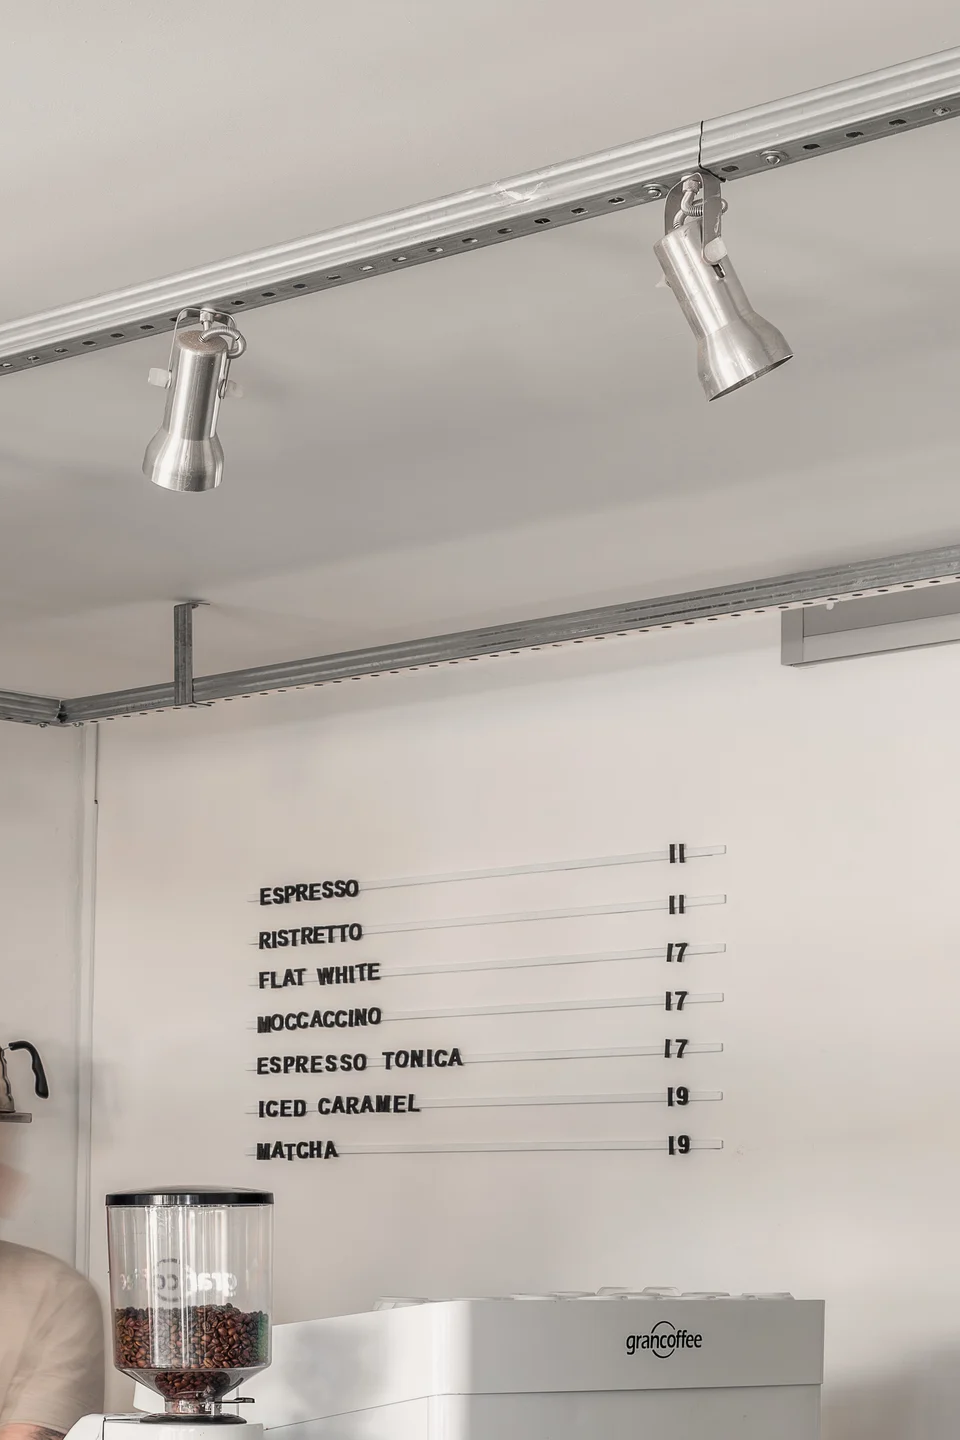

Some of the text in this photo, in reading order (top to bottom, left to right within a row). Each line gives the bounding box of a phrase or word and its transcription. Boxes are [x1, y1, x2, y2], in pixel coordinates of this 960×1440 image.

[259, 843, 686, 906] ESPRESSO 11
[258, 894, 686, 950] RISTRETTO 11
[258, 942, 688, 989] FLAT WHITE 17
[257, 990, 688, 1034] MOCCACCINO 17
[256, 1038, 689, 1075] ESPRESSO TONICA 17
[258, 1086, 690, 1118] ICED CARAMEL 19
[256, 1134, 691, 1161] MATCHA 19
[626, 1329, 703, 1356] grancoffee
